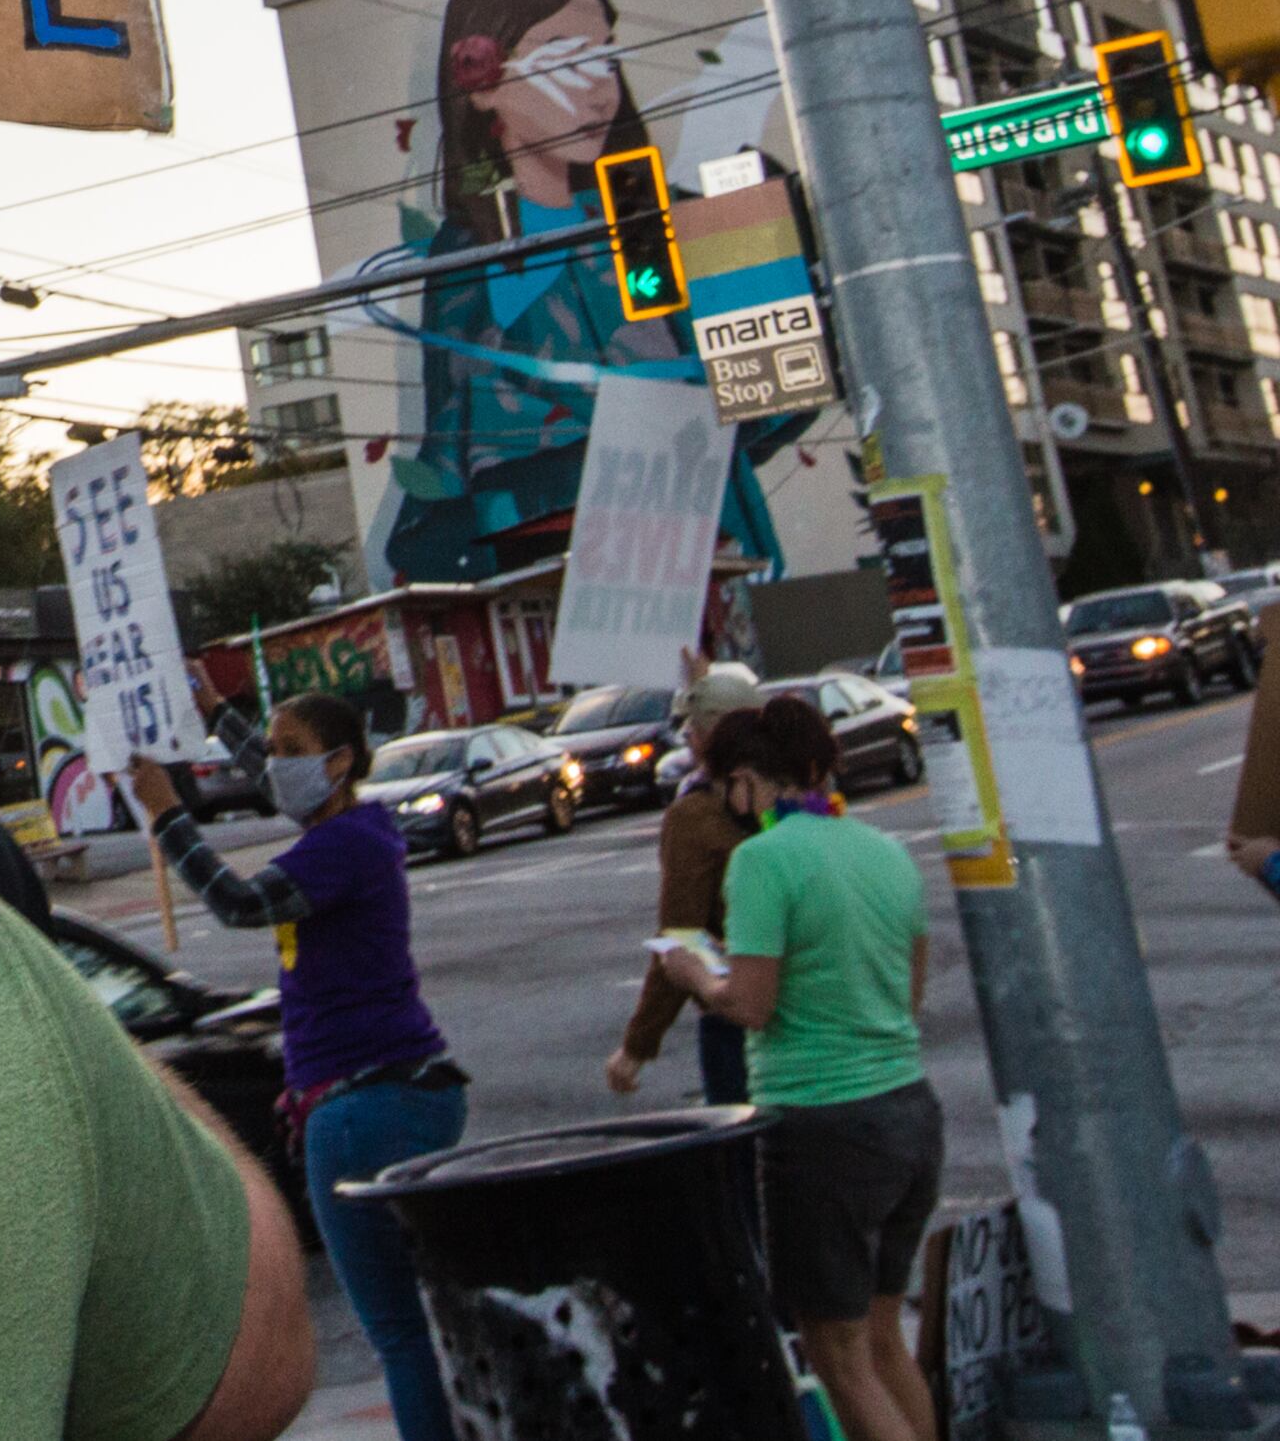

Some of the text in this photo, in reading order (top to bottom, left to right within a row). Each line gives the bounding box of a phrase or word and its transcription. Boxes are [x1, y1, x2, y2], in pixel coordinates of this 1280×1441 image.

[949, 99, 1099, 160] ulevard
[705, 307, 812, 351] marta
[713, 359, 761, 382] Bus
[717, 380, 774, 406] Stop
[65, 465, 138, 566] SEE
[92, 559, 131, 622] US
